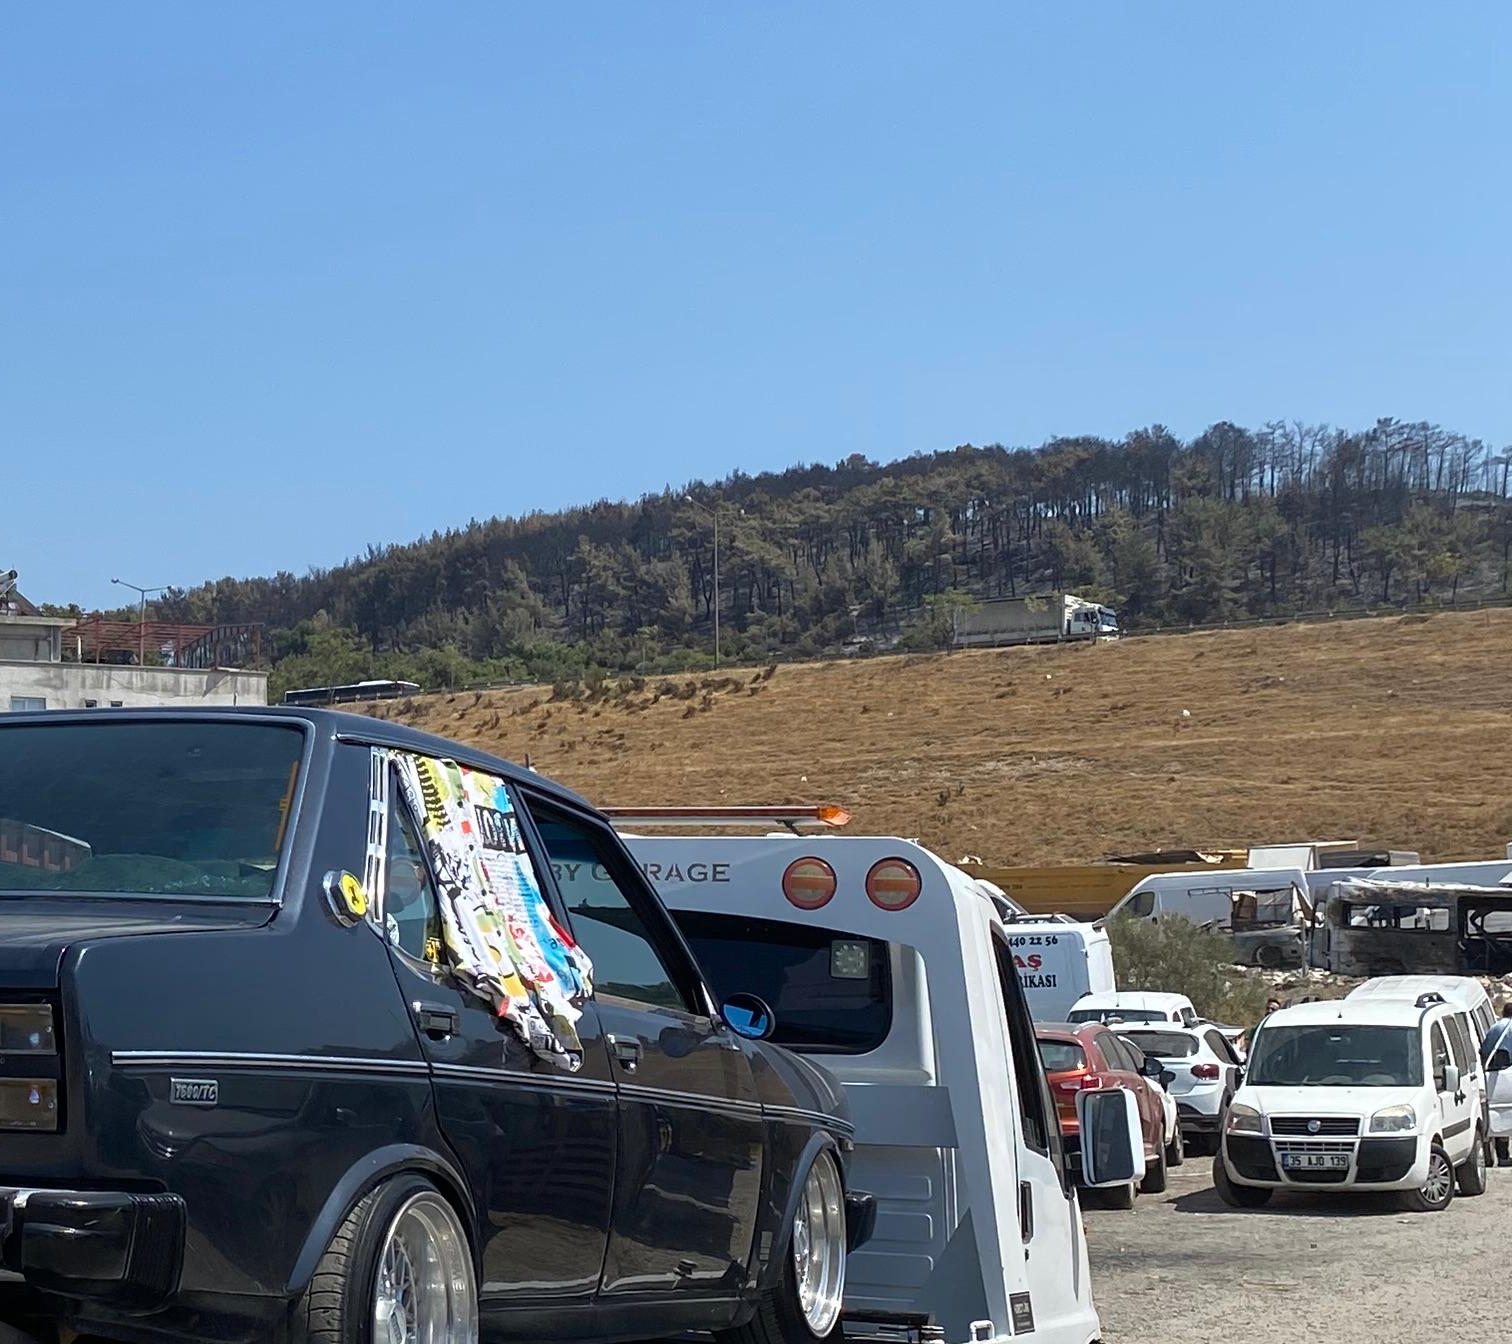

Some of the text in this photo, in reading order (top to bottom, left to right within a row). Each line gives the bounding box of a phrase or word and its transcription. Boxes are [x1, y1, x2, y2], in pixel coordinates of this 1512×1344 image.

[591, 863, 730, 882] GRAGE
[1029, 936, 1043, 946] 22
[1045, 935, 1058, 946] 56
